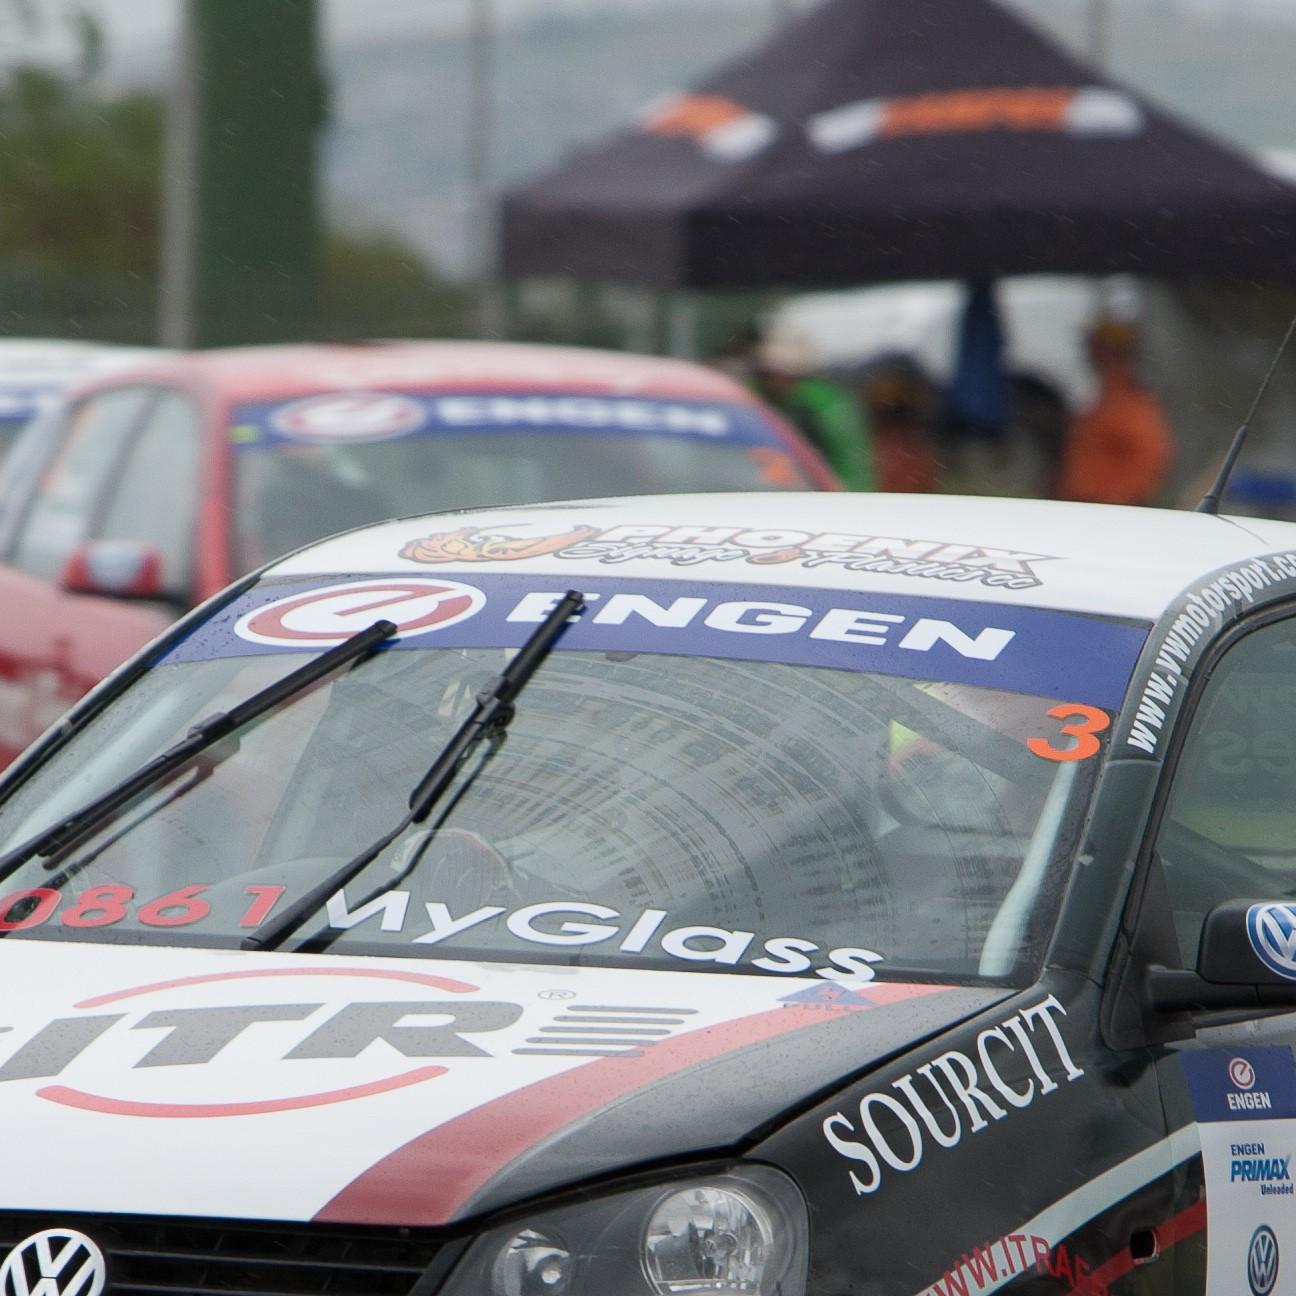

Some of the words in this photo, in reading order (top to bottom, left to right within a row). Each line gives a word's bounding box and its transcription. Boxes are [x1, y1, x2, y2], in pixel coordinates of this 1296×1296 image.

[592, 524, 1069, 580] PHOENIX
[506, 589, 1016, 662] ENGEN
[1026, 702, 1111, 763] 3
[326, 888, 884, 983] MyGlass
[822, 993, 1086, 1196] SOURCIT
[1226, 1090, 1272, 1111] ENGEN
[1230, 1142, 1265, 1157] ENGEN
[1230, 1153, 1292, 1184] PRIMAX
[1260, 1183, 1294, 1196] Unleaded
